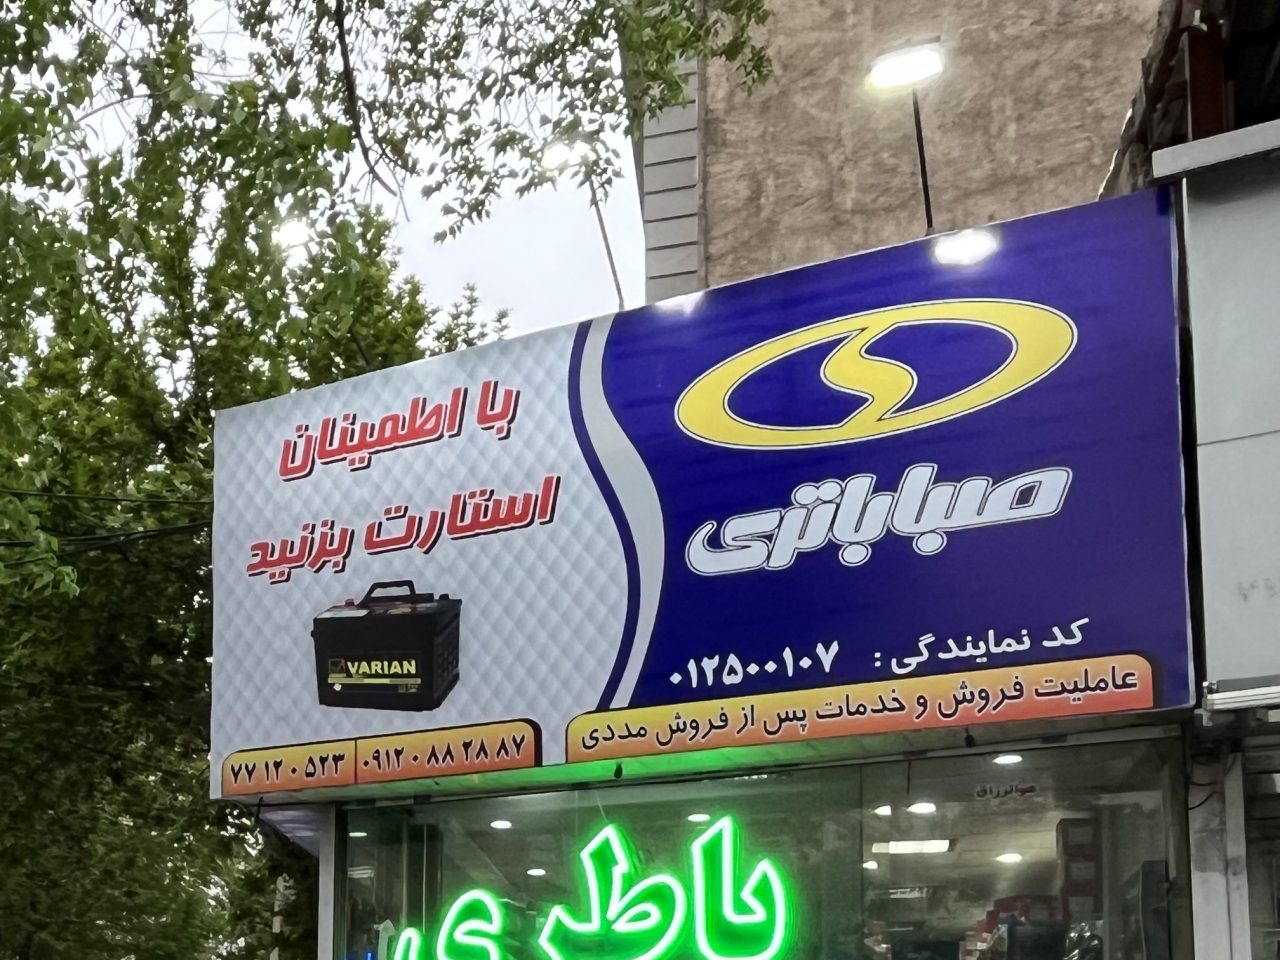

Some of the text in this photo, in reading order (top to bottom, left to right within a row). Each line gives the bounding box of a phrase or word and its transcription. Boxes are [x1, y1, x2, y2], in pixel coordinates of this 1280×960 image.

[278, 380, 520, 481] با اطمینان
[246, 475, 561, 584] استارت بزنید
[669, 640, 839, 688] ۰۱۲۵۰۰۱۰۷
[1042, 617, 1090, 648] کد
[347, 660, 417, 675] VARIAN
[581, 665, 1138, 750] عاملیت فروش و خدمات پس از فروش مددی
